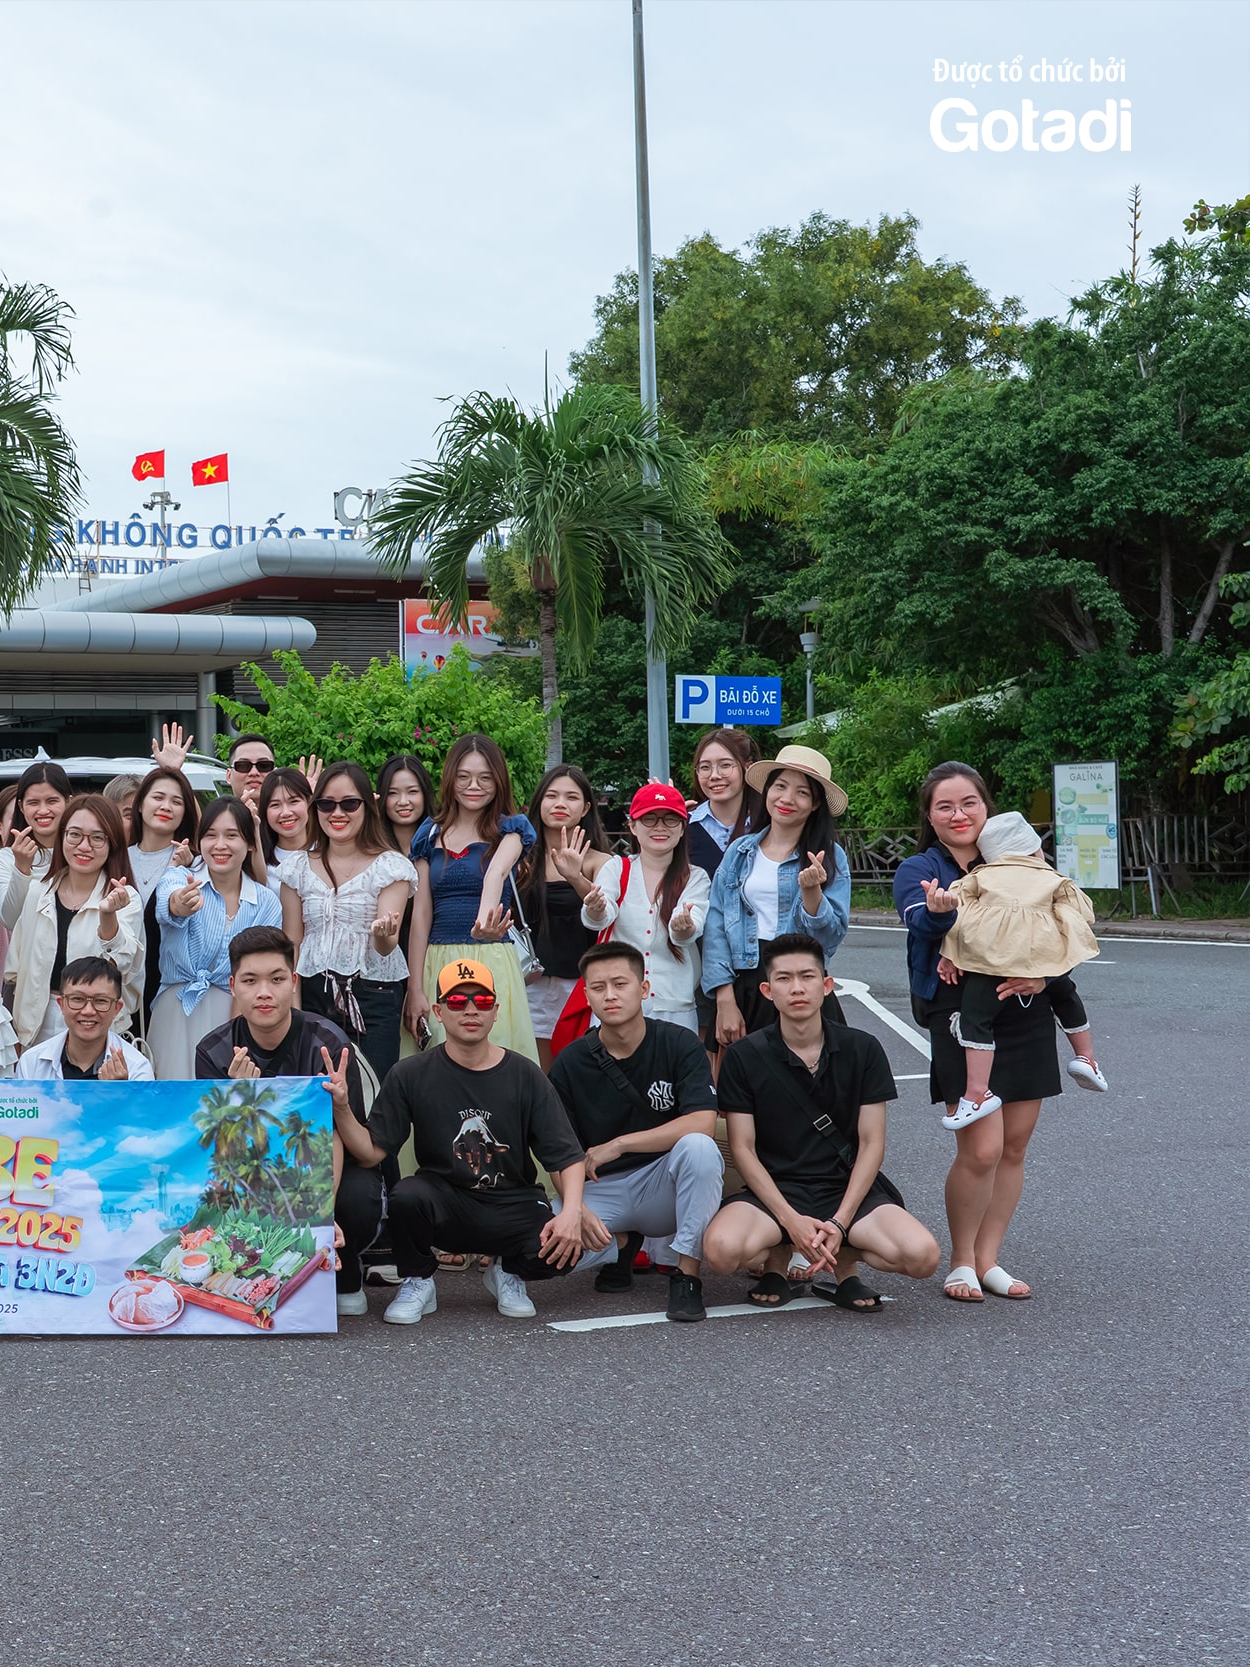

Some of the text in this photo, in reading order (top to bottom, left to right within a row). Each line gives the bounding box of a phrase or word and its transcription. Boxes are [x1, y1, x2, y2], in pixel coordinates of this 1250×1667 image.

[78, 513, 199, 549] KHÔNG
[682, 679, 709, 719] P
[720, 686, 777, 704] BÃI ĐỖ XE
[457, 963, 475, 979] LA
[648, 1080, 675, 1111] NY
